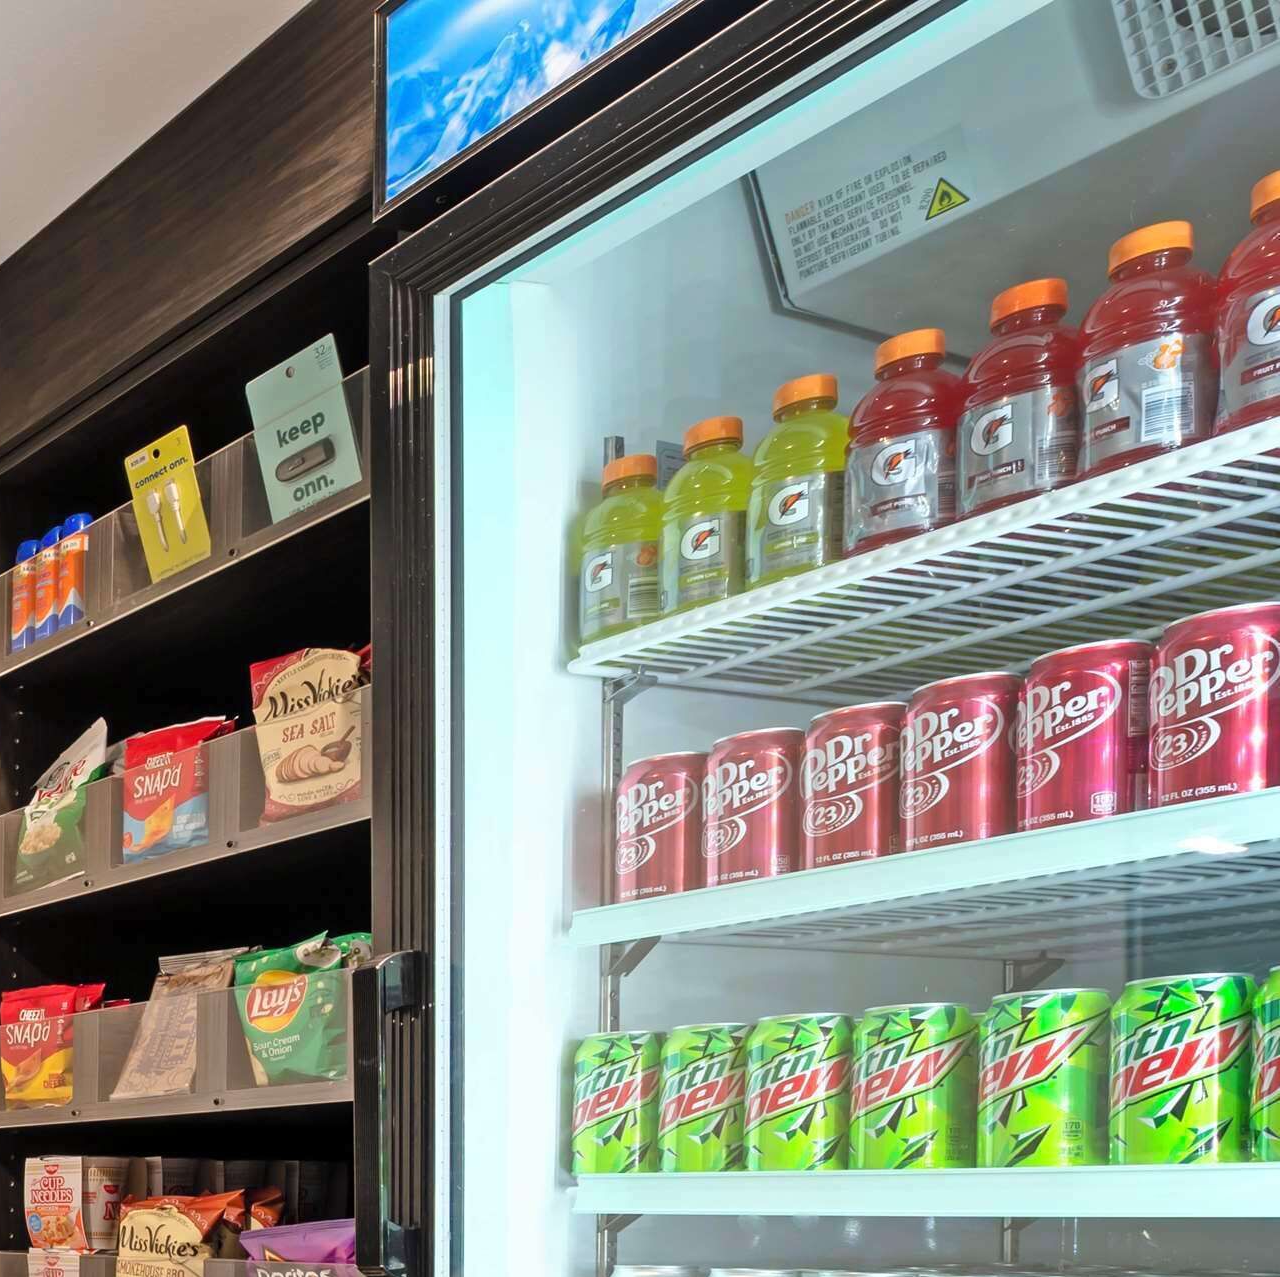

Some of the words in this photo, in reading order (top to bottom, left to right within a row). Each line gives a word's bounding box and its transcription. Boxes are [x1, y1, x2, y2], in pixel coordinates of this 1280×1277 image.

[845, 179, 861, 193] FIRE
[824, 191, 866, 217] REFRIGERANT
[276, 411, 326, 448] keep
[971, 403, 1013, 456] G
[135, 465, 168, 489] connect
[169, 456, 188, 471] onn.
[871, 439, 917, 486] G
[293, 473, 336, 502] onn.
[768, 481, 809, 526] G
[680, 518, 721, 560] G
[585, 551, 614, 593] G
[1175, 644, 1234, 681] Dr
[1027, 680, 1071, 712] Dr
[1149, 650, 1274, 723] Pepper
[263, 691, 311, 723] Miss
[913, 707, 959, 738] Dr
[1017, 686, 1111, 750] Pepper
[282, 723, 305, 743] SEA
[310, 712, 336, 736] SALT
[1055, 711, 1094, 735] Est.1885
[825, 732, 873, 761] Dr
[900, 713, 994, 779] Pepper
[1161, 732, 1187, 759] 23
[716, 759, 755, 786] Dr
[803, 742, 900, 800] Pepper
[1017, 764, 1035, 786] 23
[627, 780, 664, 808] Dr
[702, 766, 785, 822] Pepper
[905, 786, 922, 806] 23
[1170, 792, 1180, 801] FL
[1181, 788, 1193, 798] OZ
[1194, 784, 1216, 797] (355
[1218, 782, 1238, 794] mL)
[815, 806, 837, 826] 23
[815, 856, 823, 864] 12
[823, 855, 832, 863] FL
[832, 853, 842, 861] OZ
[249, 979, 305, 1018] Lay's
[253, 1040, 273, 1052] Sour
[273, 1033, 301, 1048] Cream
[261, 1049, 268, 1058] &
[268, 1044, 293, 1058] Onion
[31, 1187, 74, 1205] NOODLES
[41, 1176, 65, 1190] CUP
[145, 1223, 200, 1262] Vickie's
